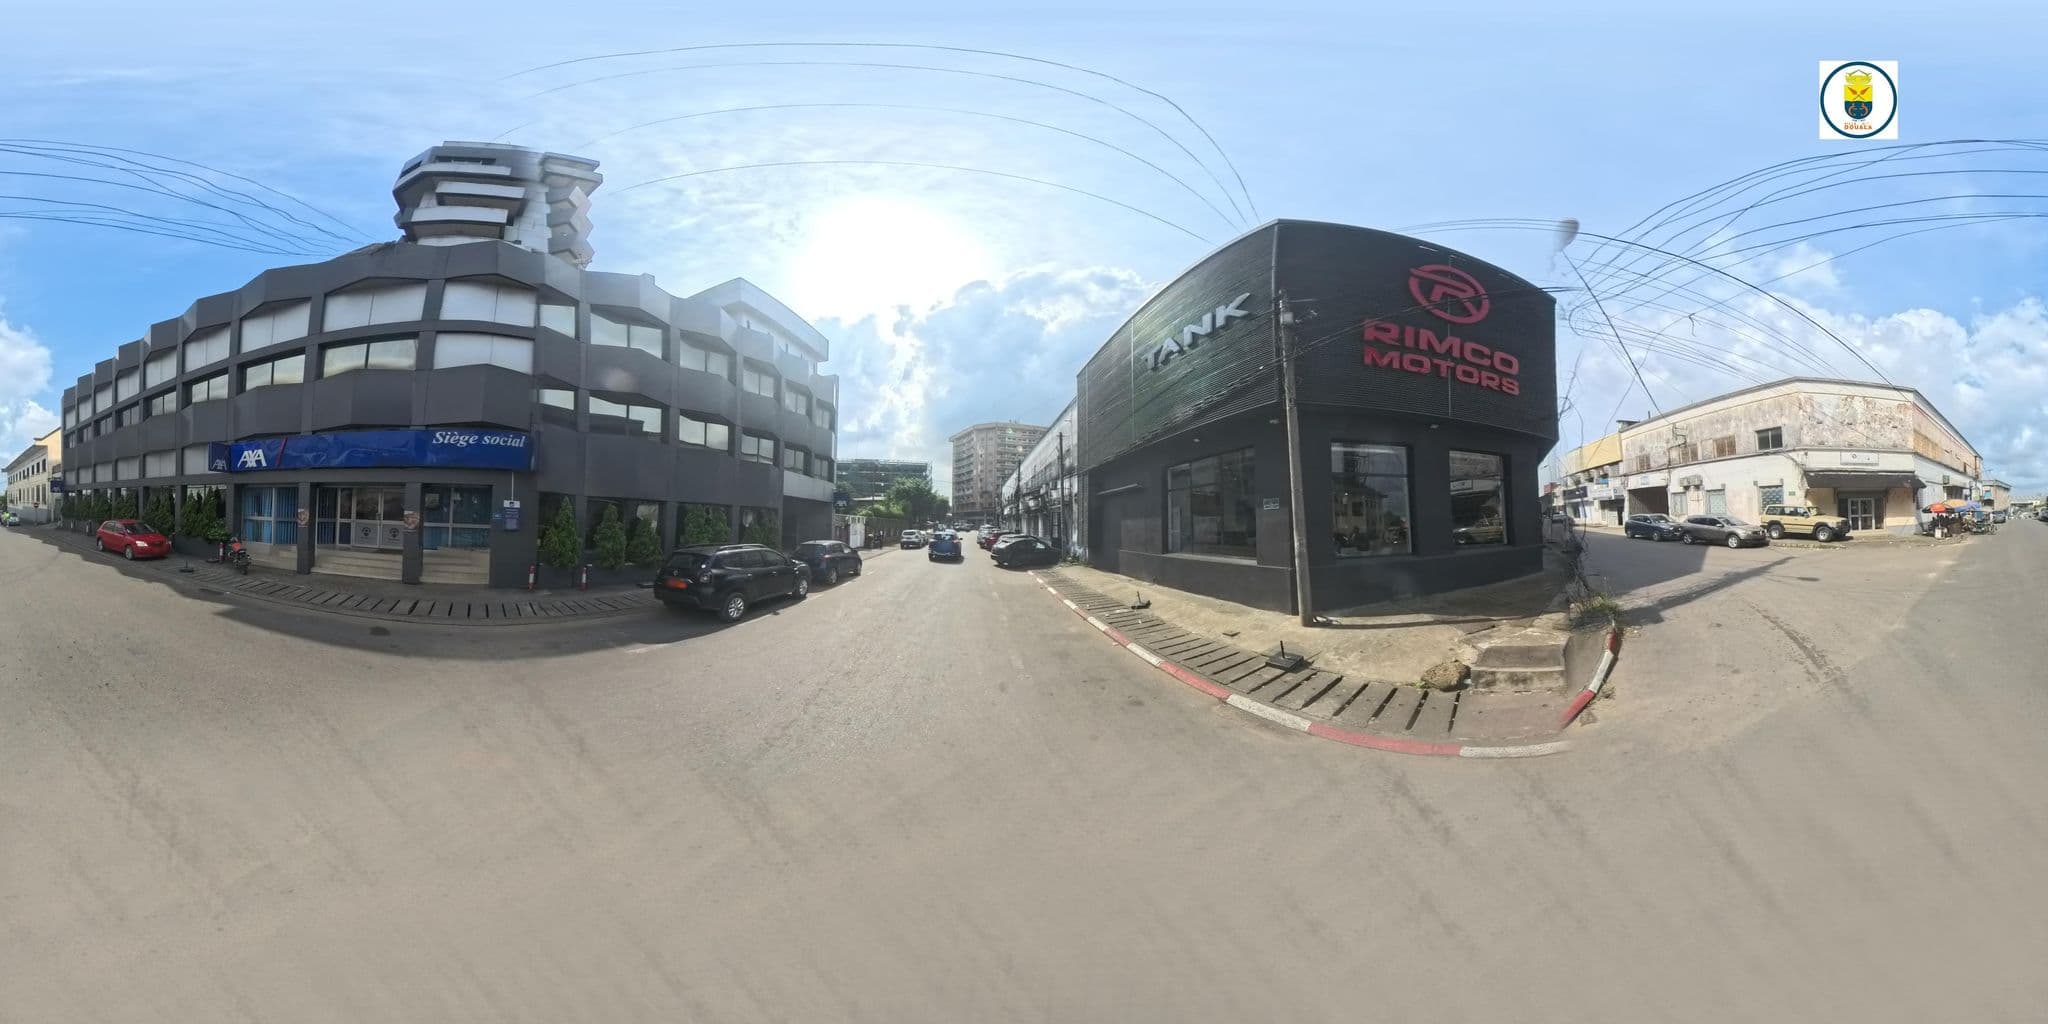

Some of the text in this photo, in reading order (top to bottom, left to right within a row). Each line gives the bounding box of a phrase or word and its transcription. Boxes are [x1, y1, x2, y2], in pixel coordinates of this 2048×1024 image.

[1141, 292, 1251, 369] TANK
[1363, 319, 1520, 376] RIMCO
[1363, 345, 1520, 396] MOTORS
[237, 449, 267, 468] AXA
[432, 431, 526, 448] Siège social
